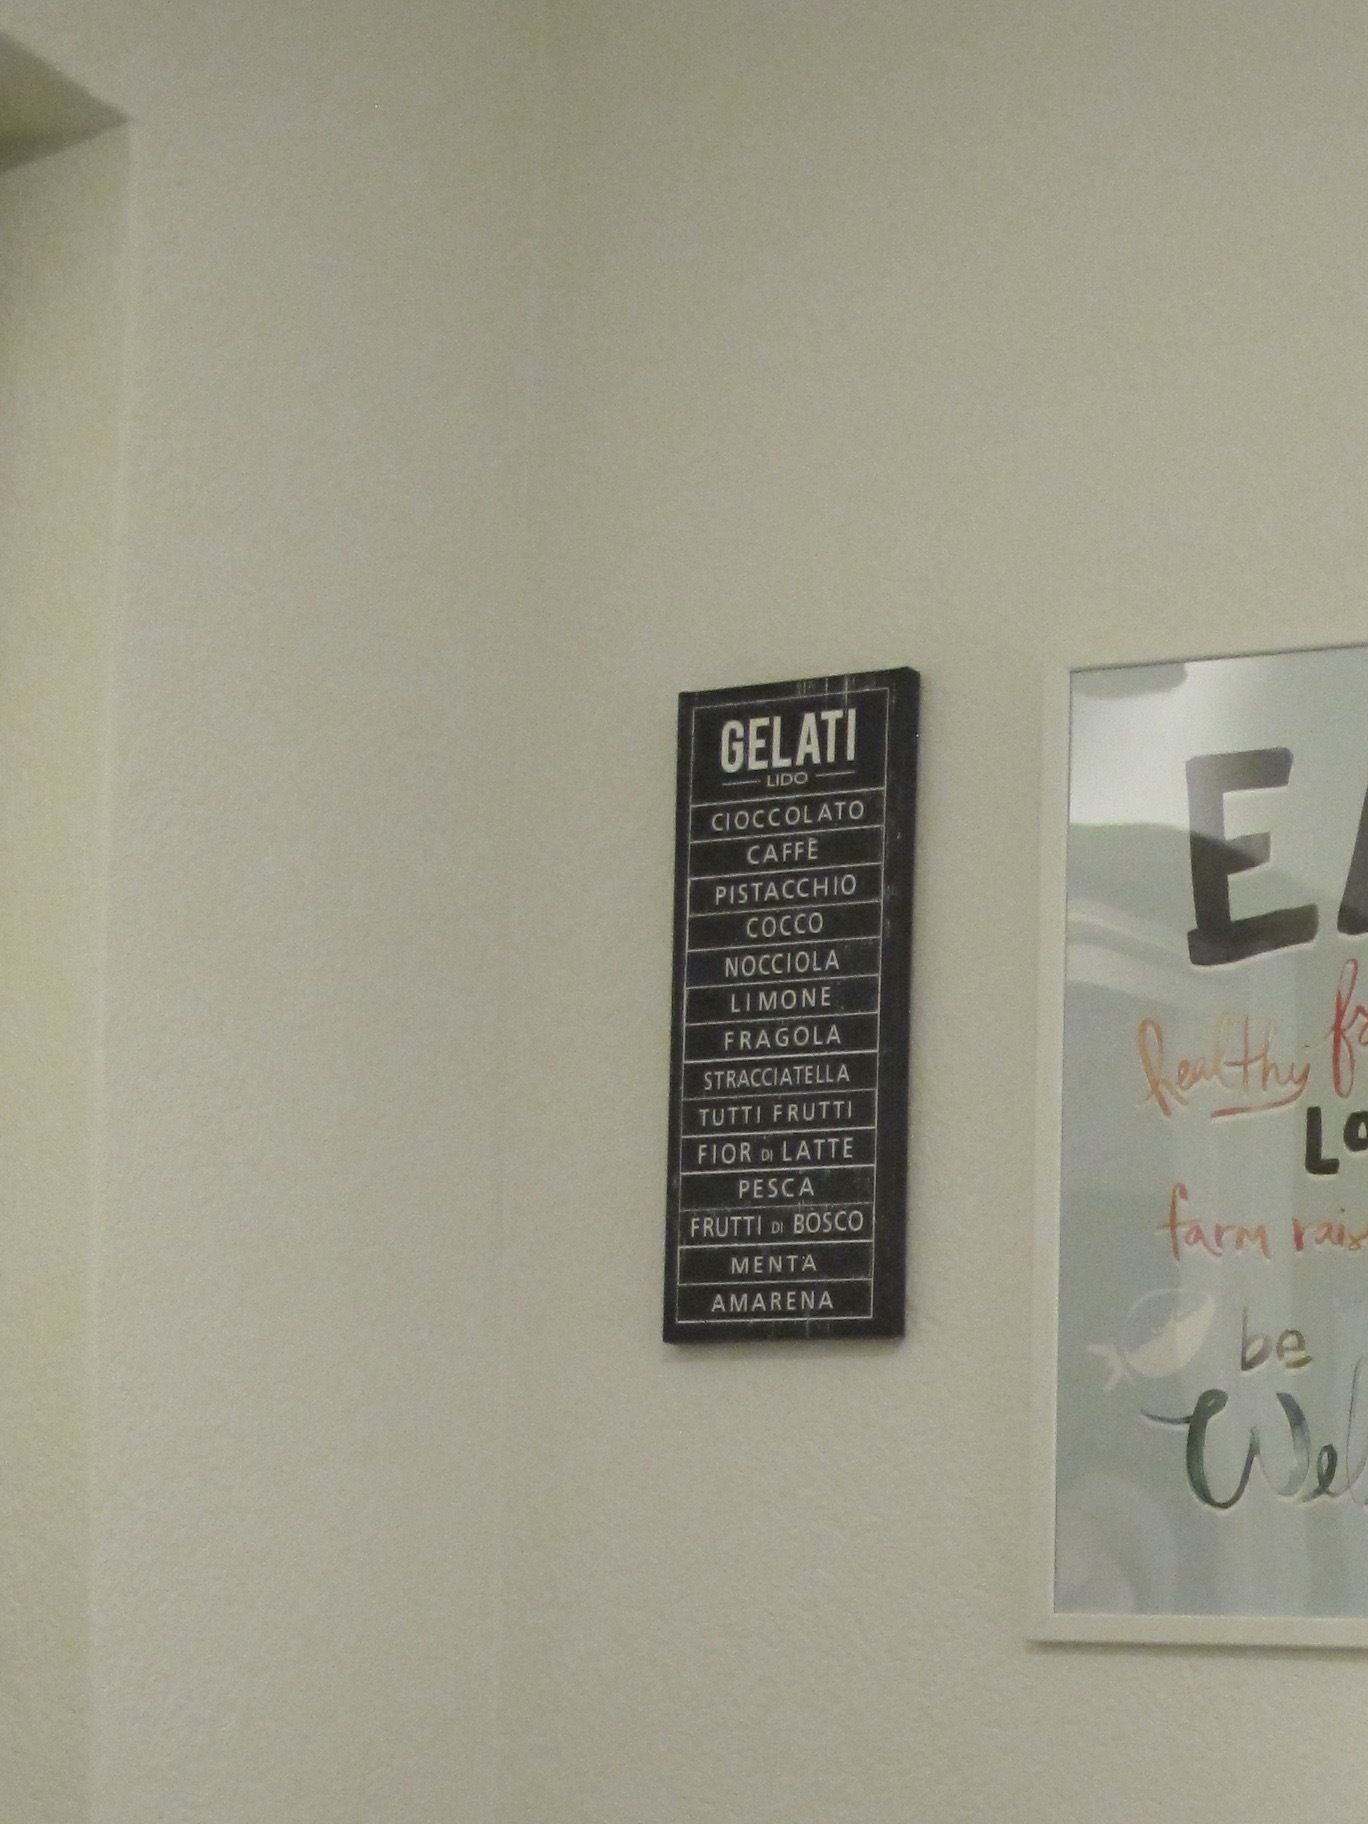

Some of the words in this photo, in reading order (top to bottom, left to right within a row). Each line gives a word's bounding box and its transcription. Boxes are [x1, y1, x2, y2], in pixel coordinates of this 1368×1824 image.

[721, 708, 856, 773] GELATI
[767, 772, 808, 787] LIDO
[712, 800, 864, 832] CIOCCOLATO
[716, 874, 856, 905] PISTACCHIO
[747, 912, 823, 937] COCCO
[725, 950, 839, 977] NOCCIOLA
[731, 987, 831, 1013] LIMONE
[725, 1024, 841, 1050] FRAGOLA
[704, 1064, 850, 1090] STRACCIATELLA
[1138, 1015, 1312, 1117] healthy
[700, 1106, 760, 1126] TUTTI
[773, 1101, 851, 1122] FRUTTI
[698, 1143, 751, 1164] FIOR
[761, 1149, 773, 1161] DI
[783, 1138, 852, 1161] LATTE
[739, 1177, 814, 1199] PESCA
[691, 1216, 761, 1237] FRUTTI
[772, 1222, 783, 1233] DI
[794, 1211, 863, 1234] BOSCO
[1162, 1183, 1271, 1261] farm
[731, 1254, 816, 1275] MENTA
[712, 1291, 833, 1312] AMARENA
[1240, 1307, 1313, 1372] be
